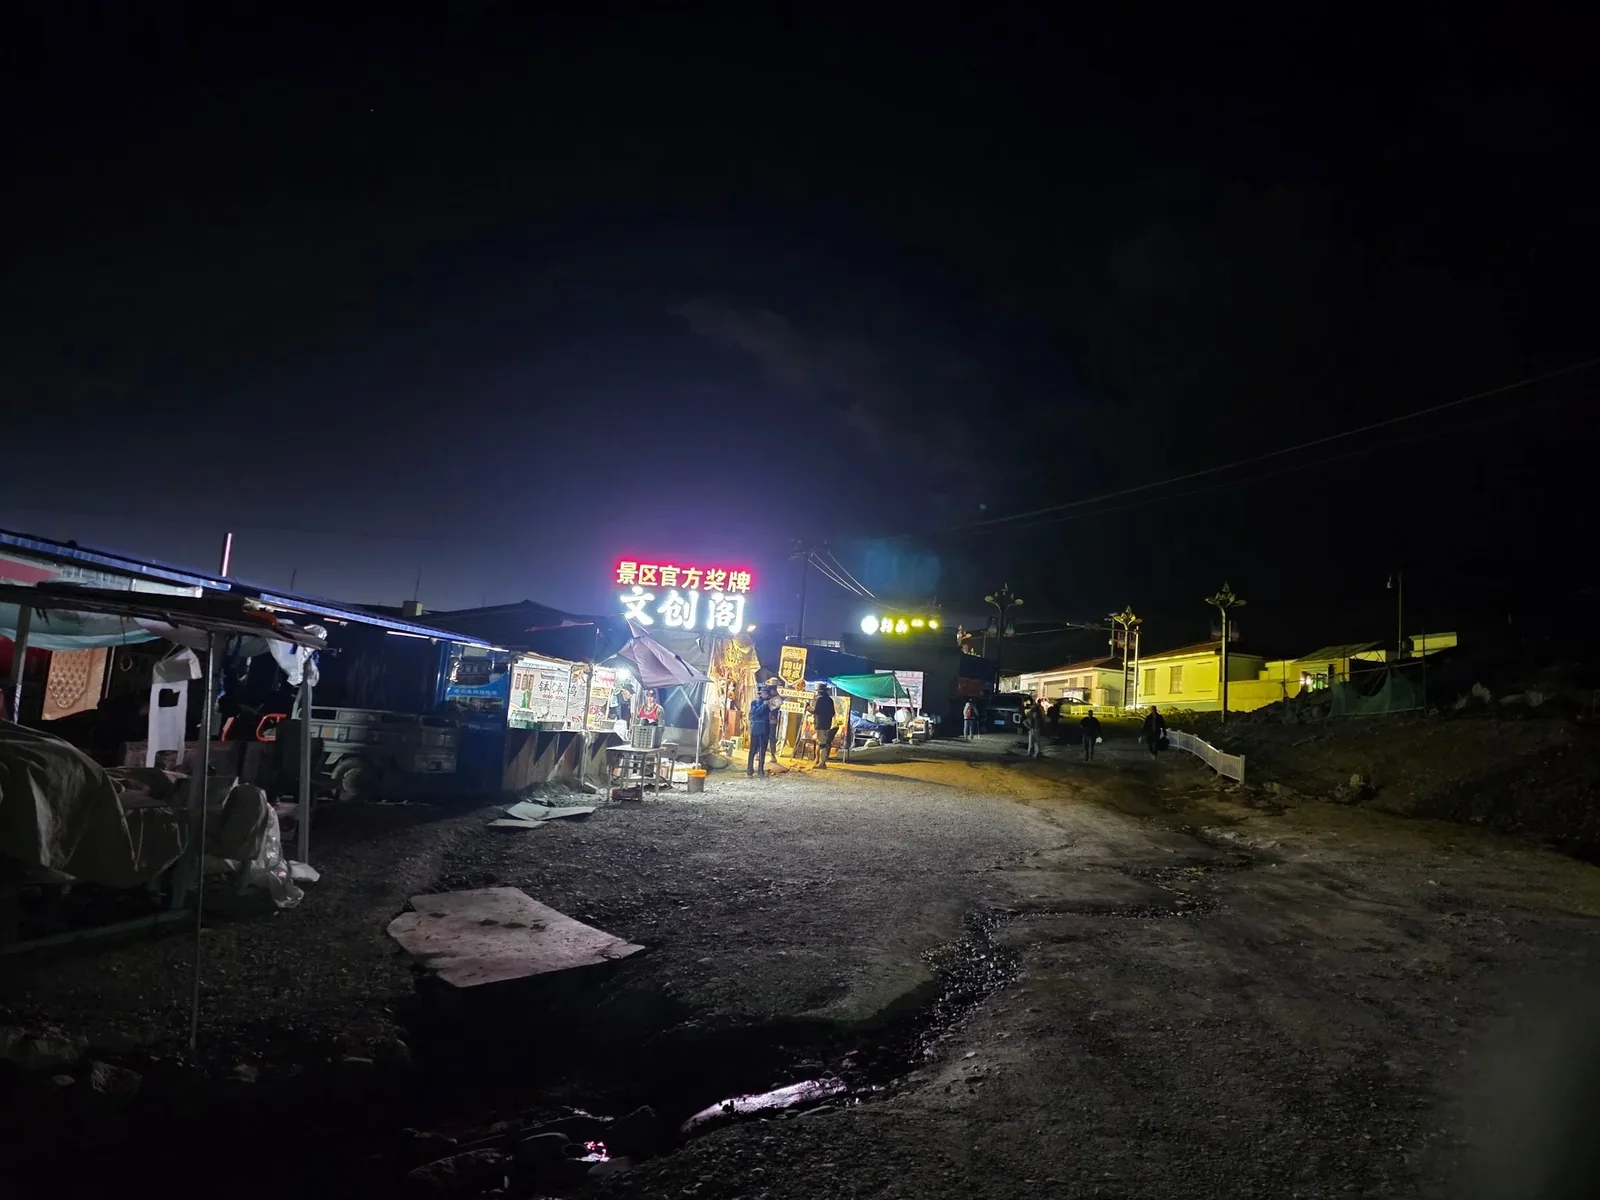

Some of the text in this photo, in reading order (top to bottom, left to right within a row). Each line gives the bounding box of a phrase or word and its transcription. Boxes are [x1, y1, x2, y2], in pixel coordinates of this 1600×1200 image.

[616, 561, 751, 594] 景区官方奖牌
[619, 586, 745, 634] 文创阁
